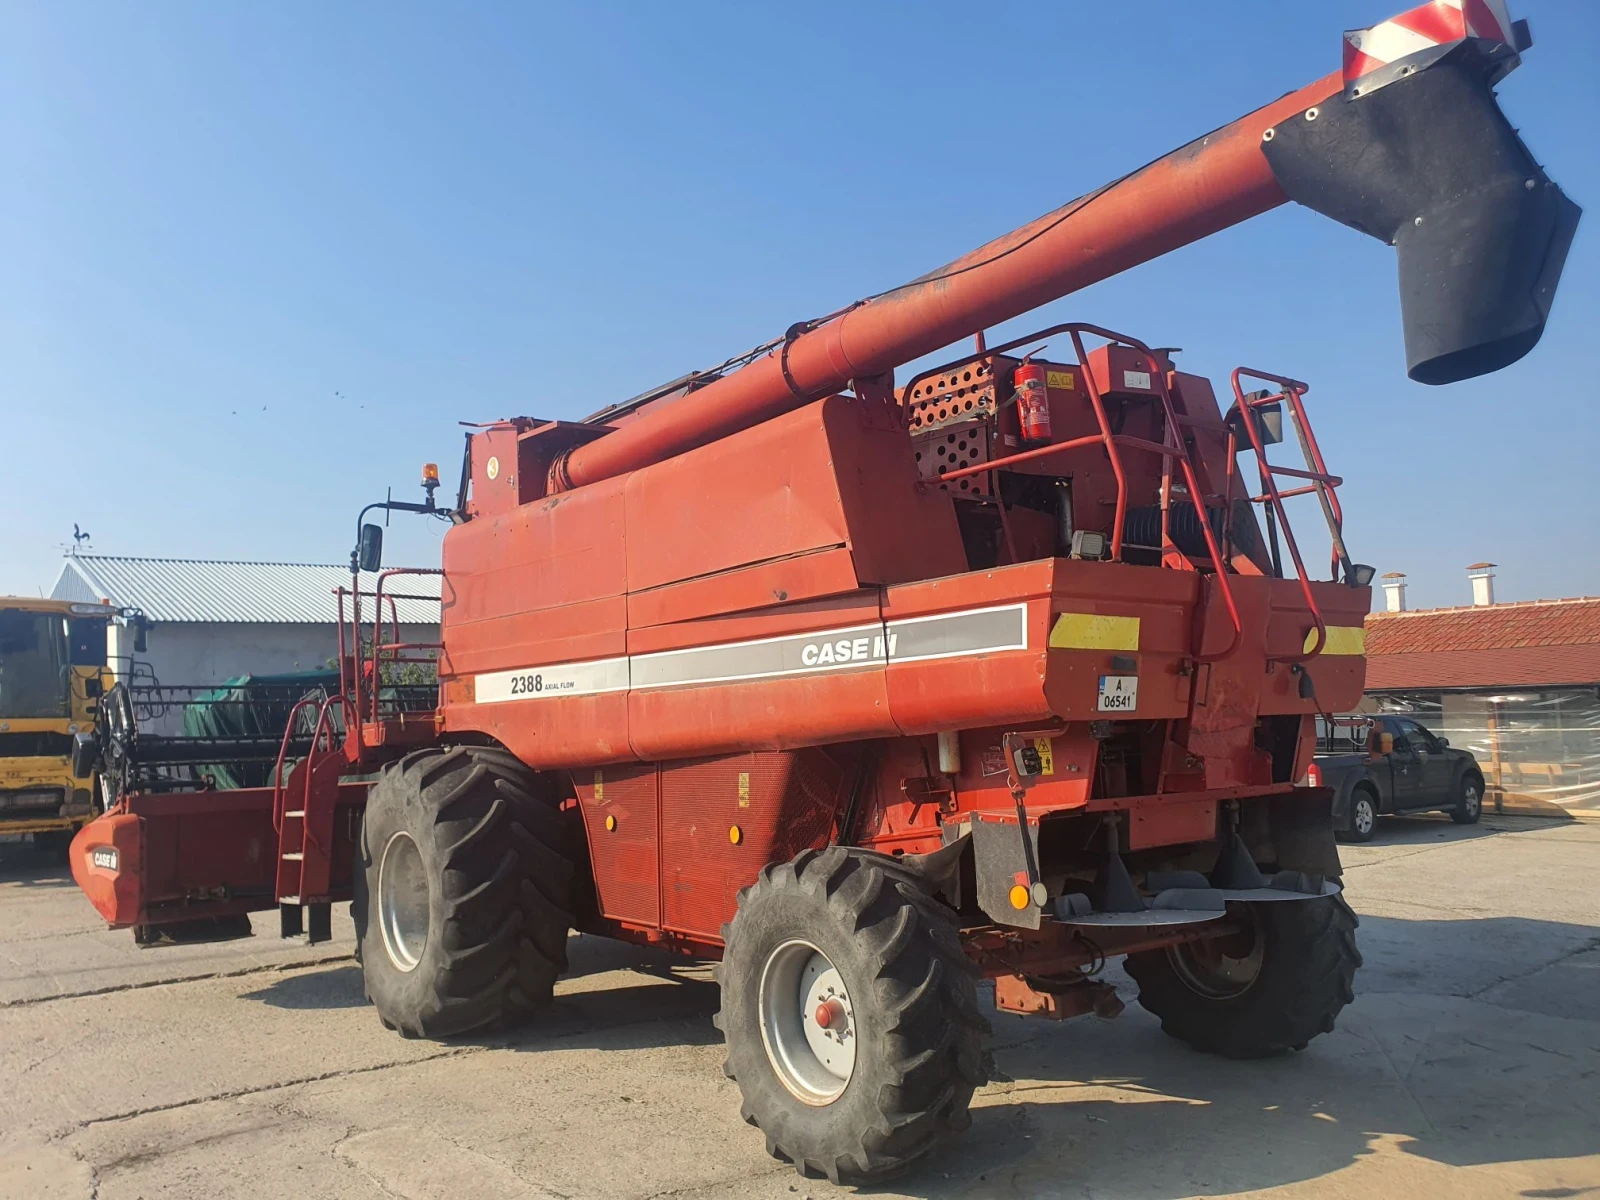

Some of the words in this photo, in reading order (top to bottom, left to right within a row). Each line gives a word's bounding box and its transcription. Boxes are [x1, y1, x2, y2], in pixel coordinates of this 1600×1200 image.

[801, 638, 869, 666] CASE
[511, 674, 543, 694] 2388
[545, 683, 560, 691] AXIAL
[560, 681, 574, 689] FLOW
[1116, 679, 1122, 691] A
[1104, 695, 1131, 708] 06541
[94, 852, 110, 867] CASE
